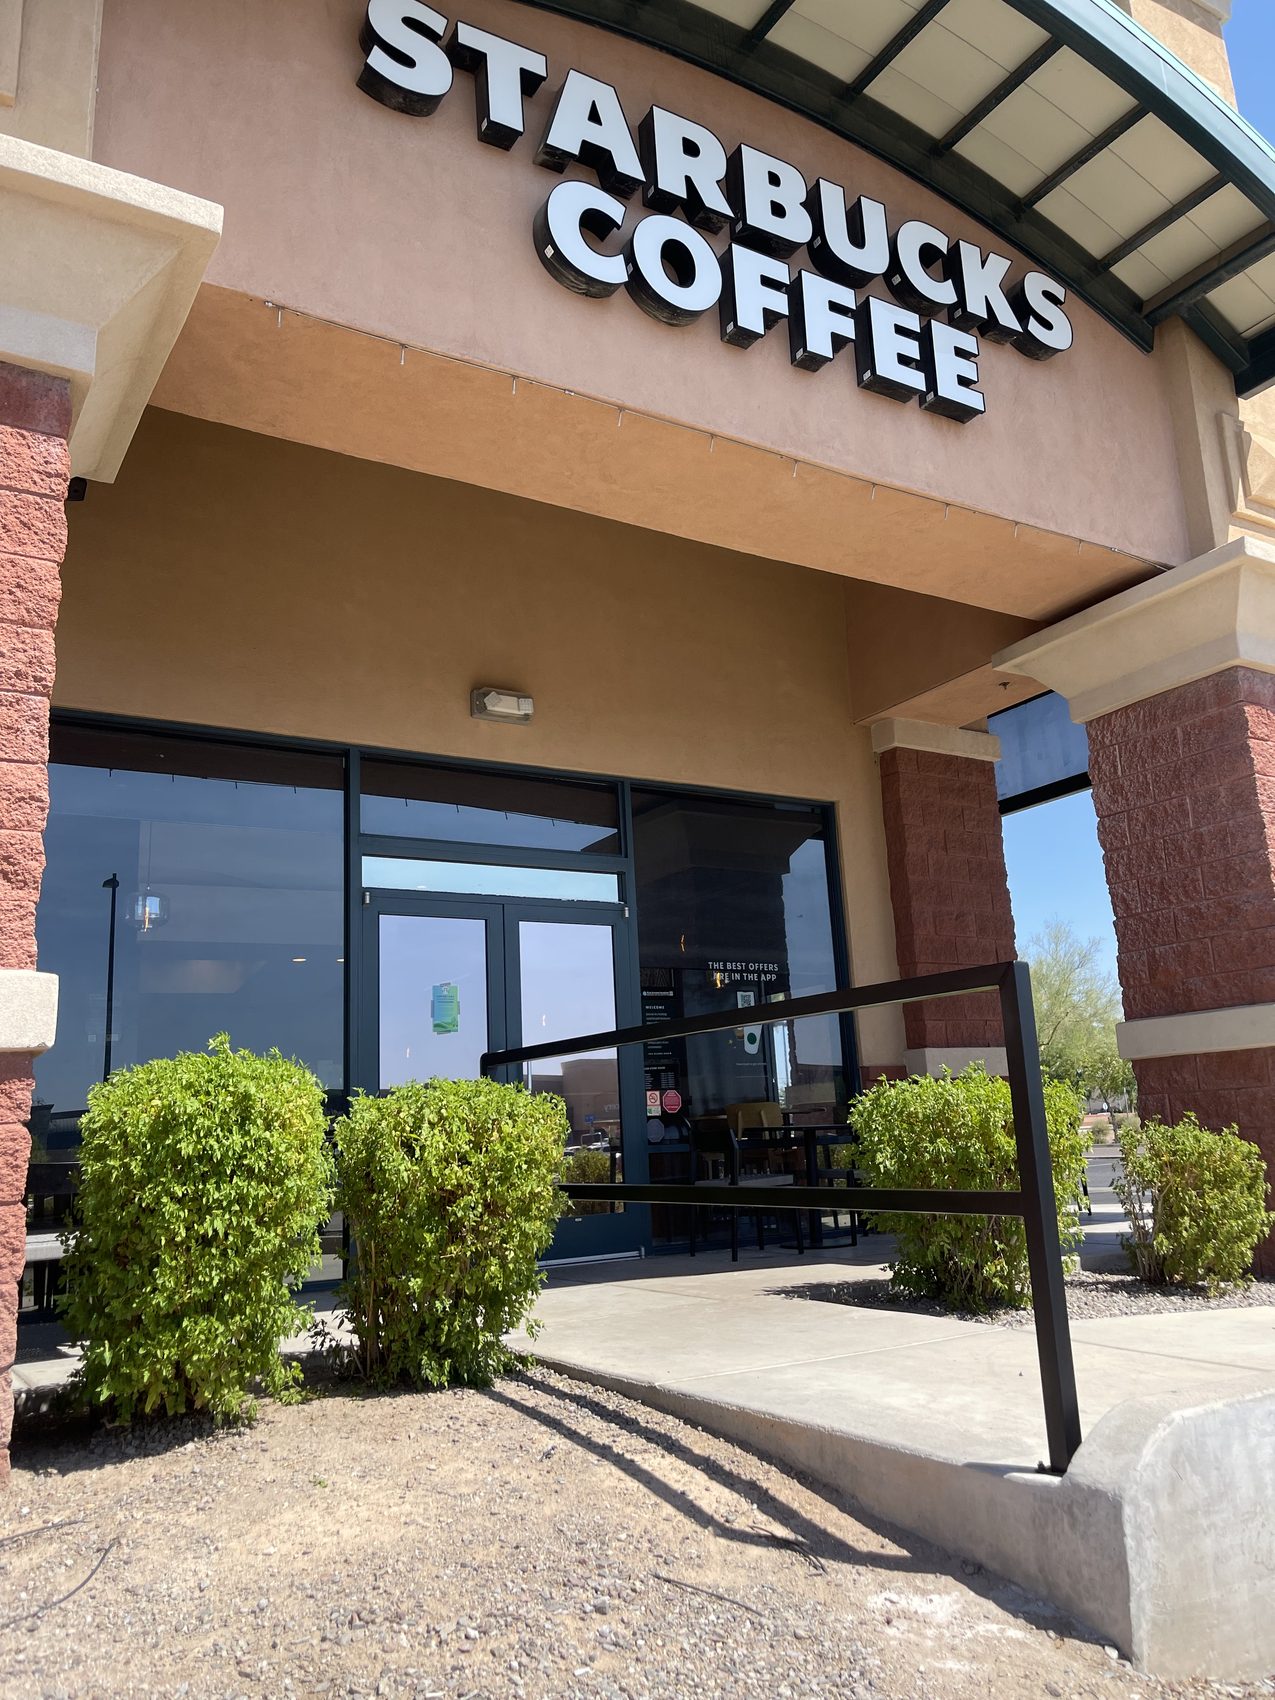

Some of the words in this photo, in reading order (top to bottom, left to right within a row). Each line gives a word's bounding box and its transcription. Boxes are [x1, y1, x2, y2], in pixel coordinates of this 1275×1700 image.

[362, 0, 1074, 356] STARBUCKS
[541, 180, 986, 419] COFFEE
[708, 961, 724, 970] THE
[726, 962, 746, 971] BEST
[748, 963, 779, 972] OFFERS
[731, 973, 741, 981] IN
[742, 973, 759, 981] THE
[760, 973, 777, 982] APP
